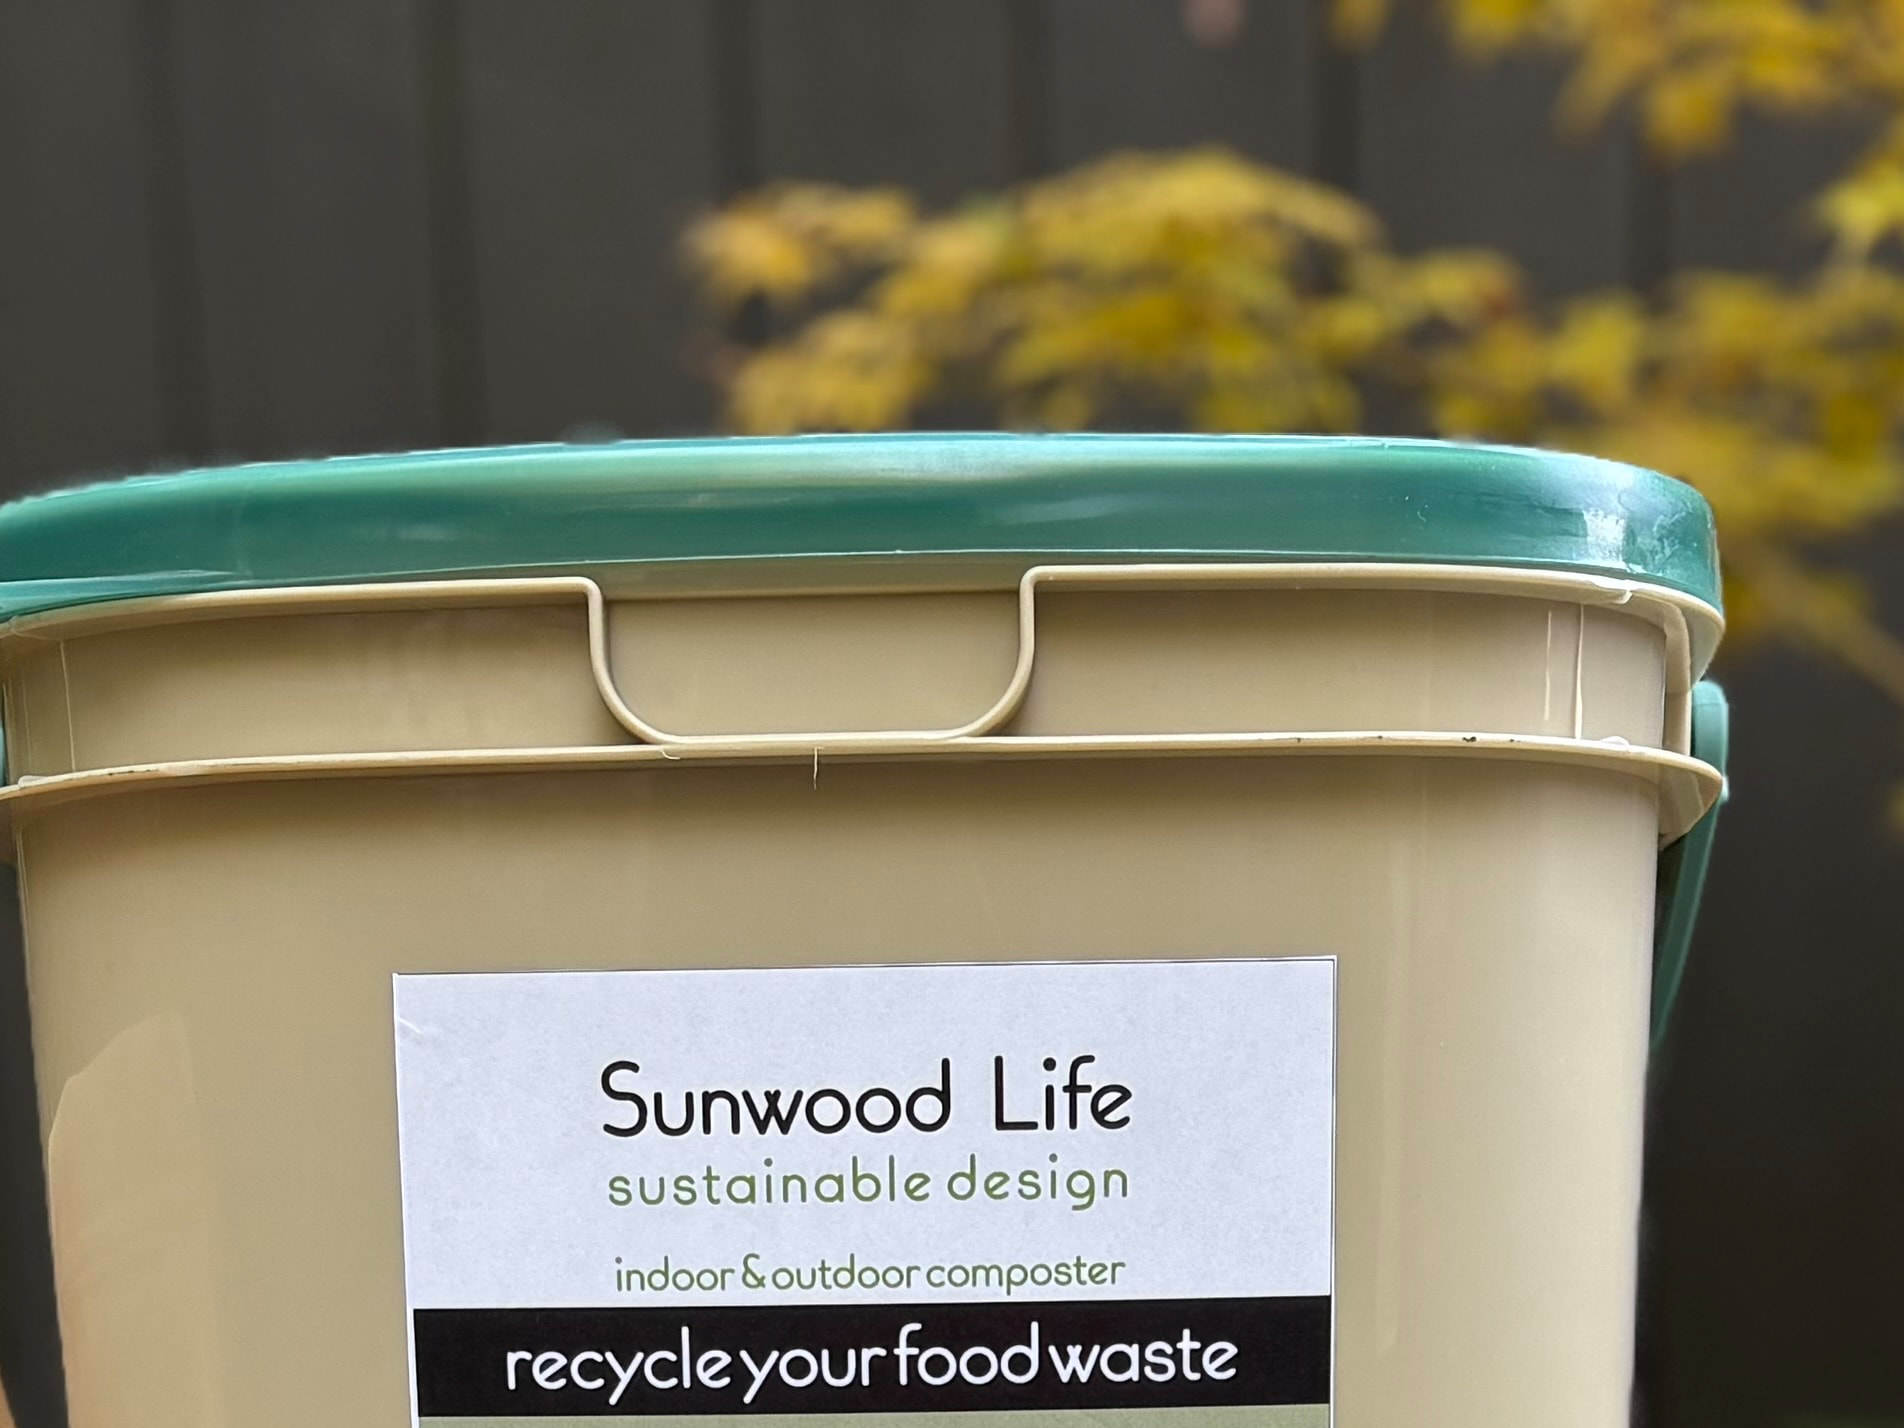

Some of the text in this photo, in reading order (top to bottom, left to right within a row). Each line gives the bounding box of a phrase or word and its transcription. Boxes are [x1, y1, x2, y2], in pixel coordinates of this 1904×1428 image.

[600, 1054, 1133, 1138] Sunwood Life
[608, 1152, 1128, 1211] sustainable design
[614, 1252, 1126, 1296] indoor & outdoor composter
[506, 1321, 1239, 1406] recycle your food waste
